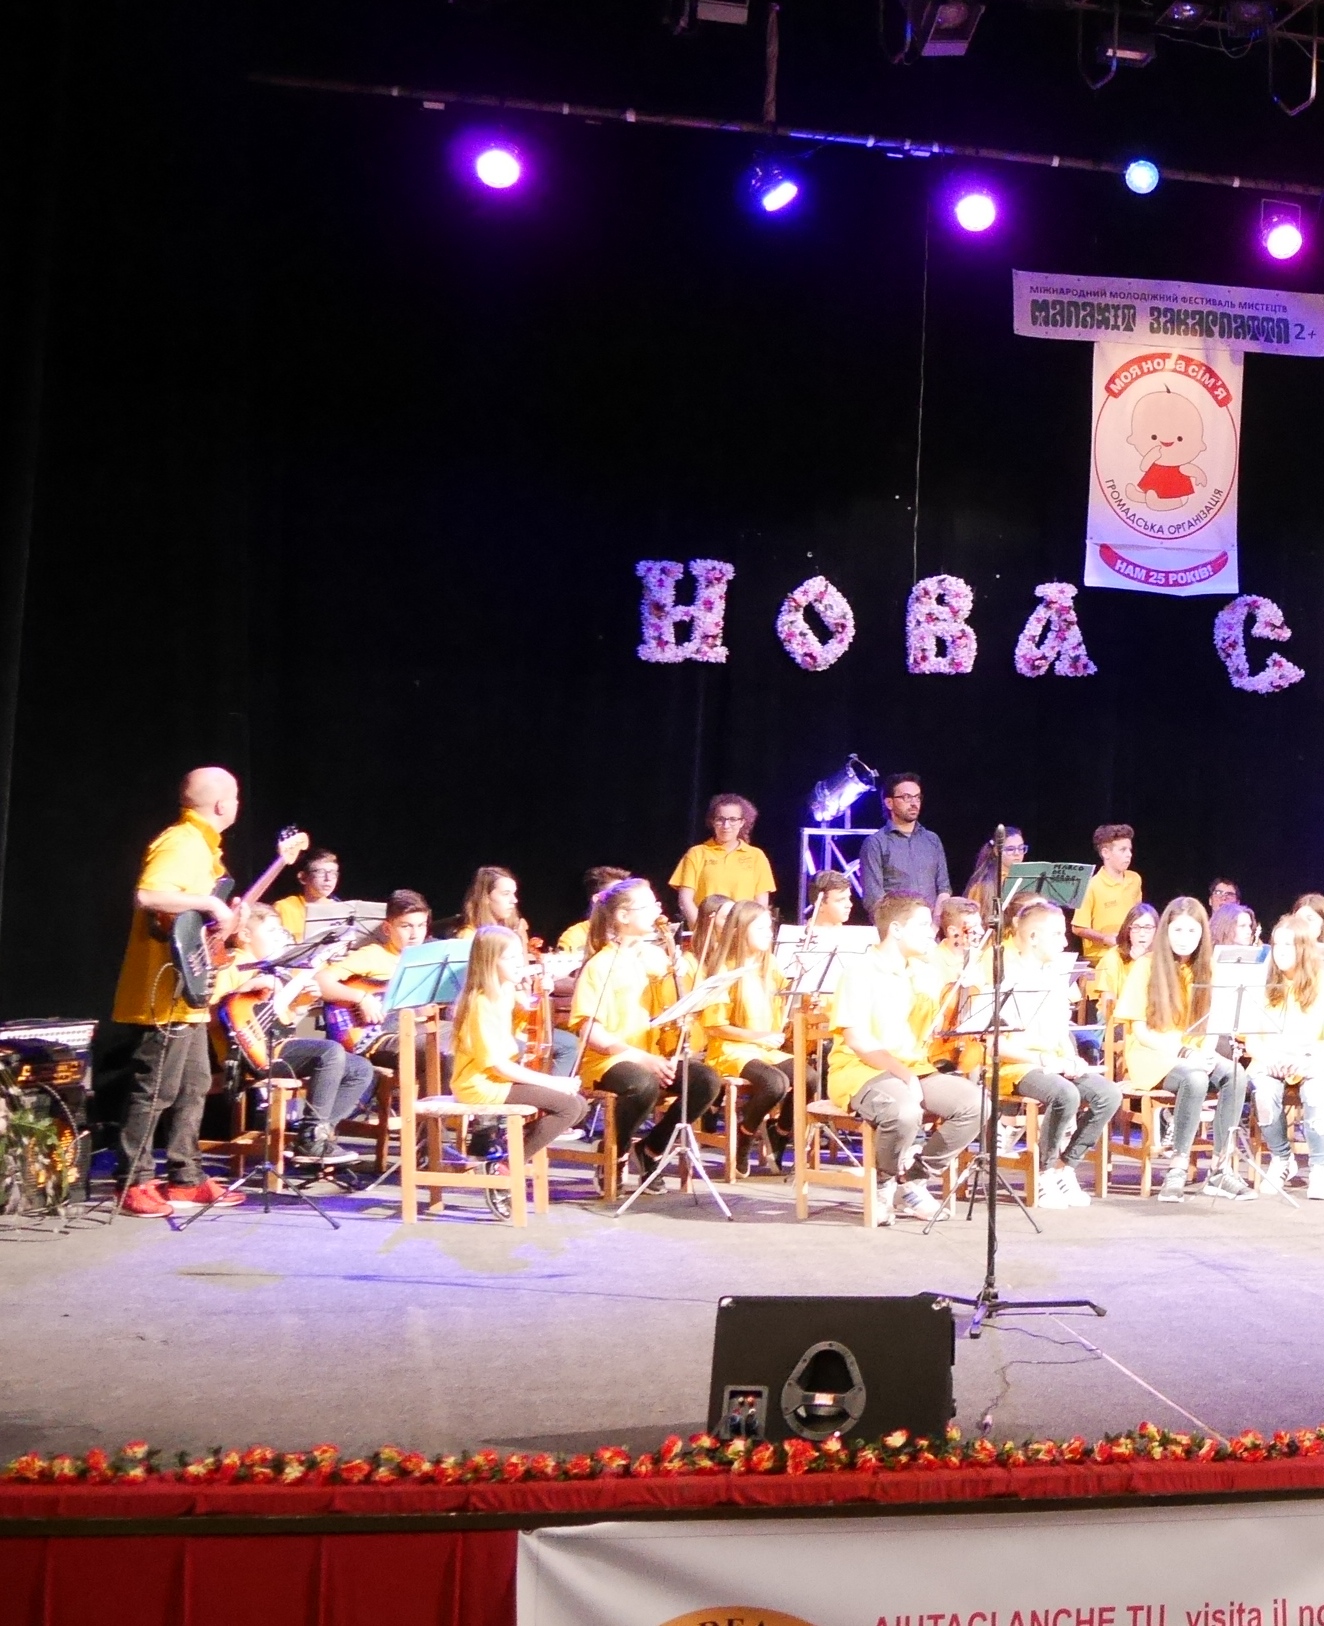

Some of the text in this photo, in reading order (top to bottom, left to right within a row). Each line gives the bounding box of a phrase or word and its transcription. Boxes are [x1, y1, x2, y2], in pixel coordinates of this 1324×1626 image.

[1029, 286, 1288, 314] МІЖНАРОДНИЙ МОЛОДІЖНИЙ ФЕСТИВАЛЬ МИСТЕЦТВ
[1105, 478, 1224, 535] ГРОМАДСЬКА ОРГАНІЗАЦІЯ
[1114, 560, 1214, 585] НАМ 25 РОКІВ!
[635, 558, 1098, 678] НОВА
[1186, 1600, 1262, 1626] visita
[1273, 1598, 1288, 1626] il
